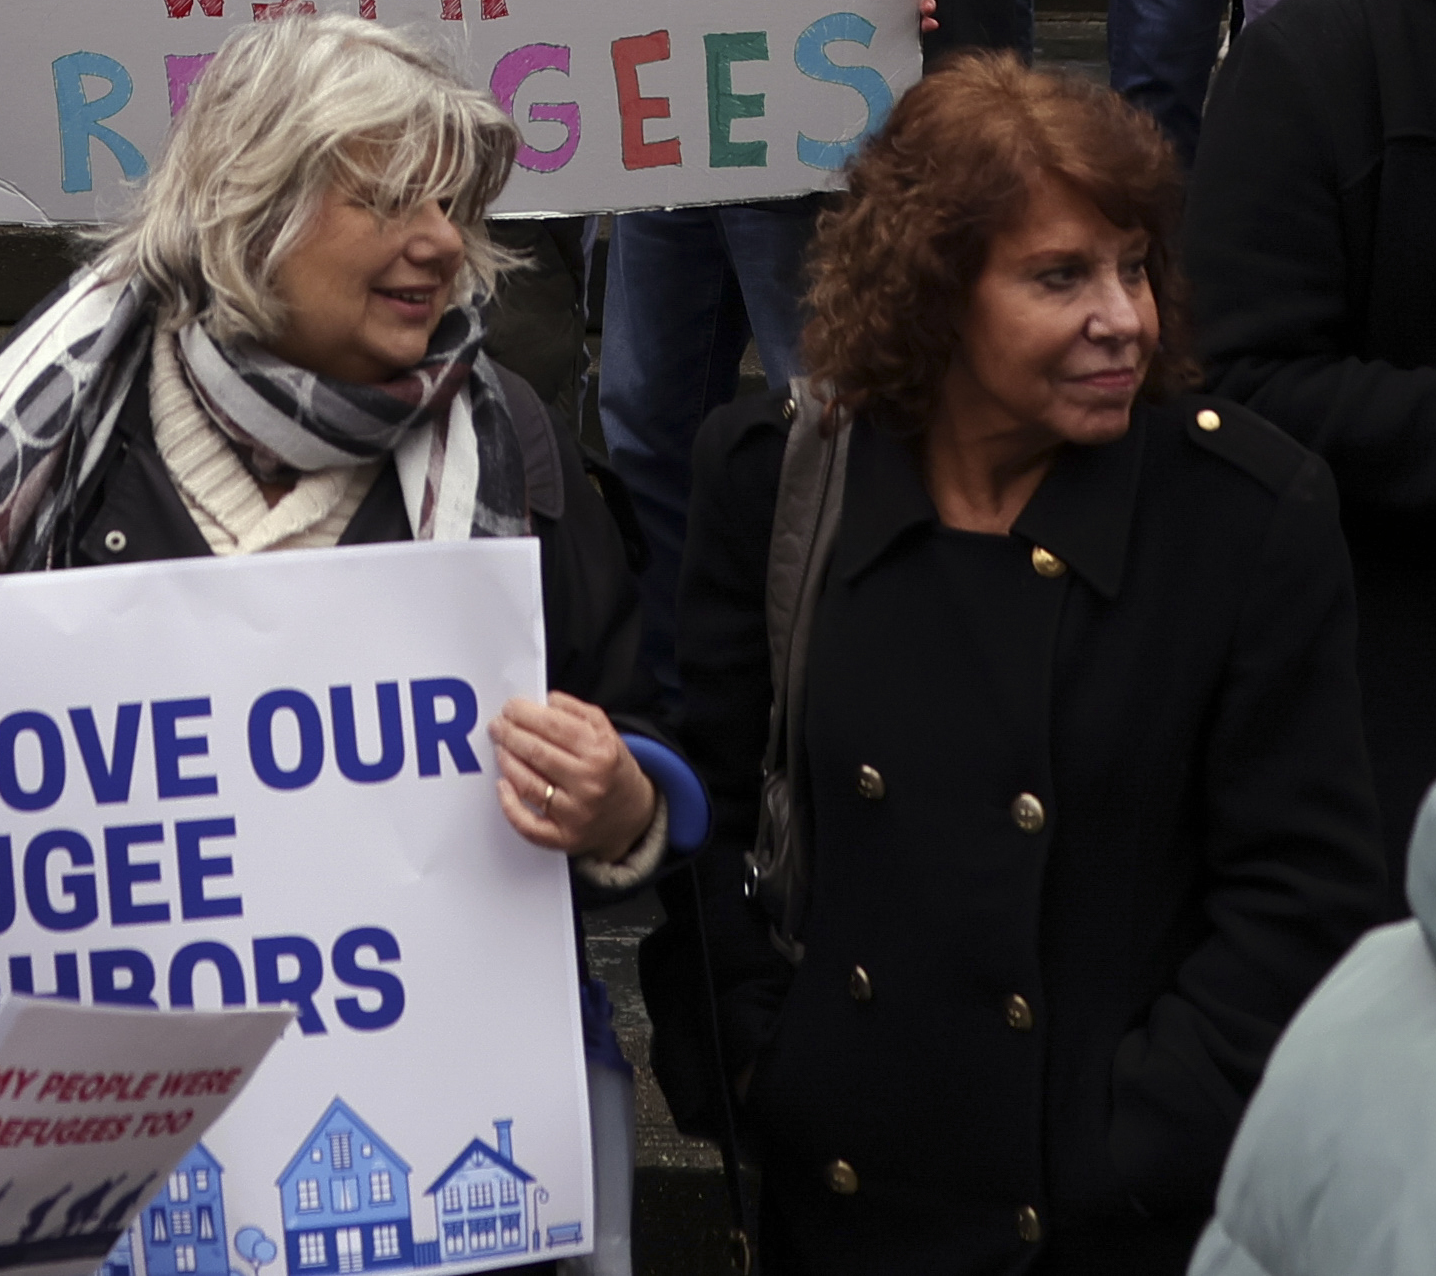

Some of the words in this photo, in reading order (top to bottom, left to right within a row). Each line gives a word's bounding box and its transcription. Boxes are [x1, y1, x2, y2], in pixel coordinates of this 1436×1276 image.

[51, 11, 896, 194] RGEES
[247, 676, 483, 791] OUR
[37, 1069, 157, 1104] PEOPLE
[160, 1066, 243, 1098] WERE
[134, 1108, 197, 1140] TOO
